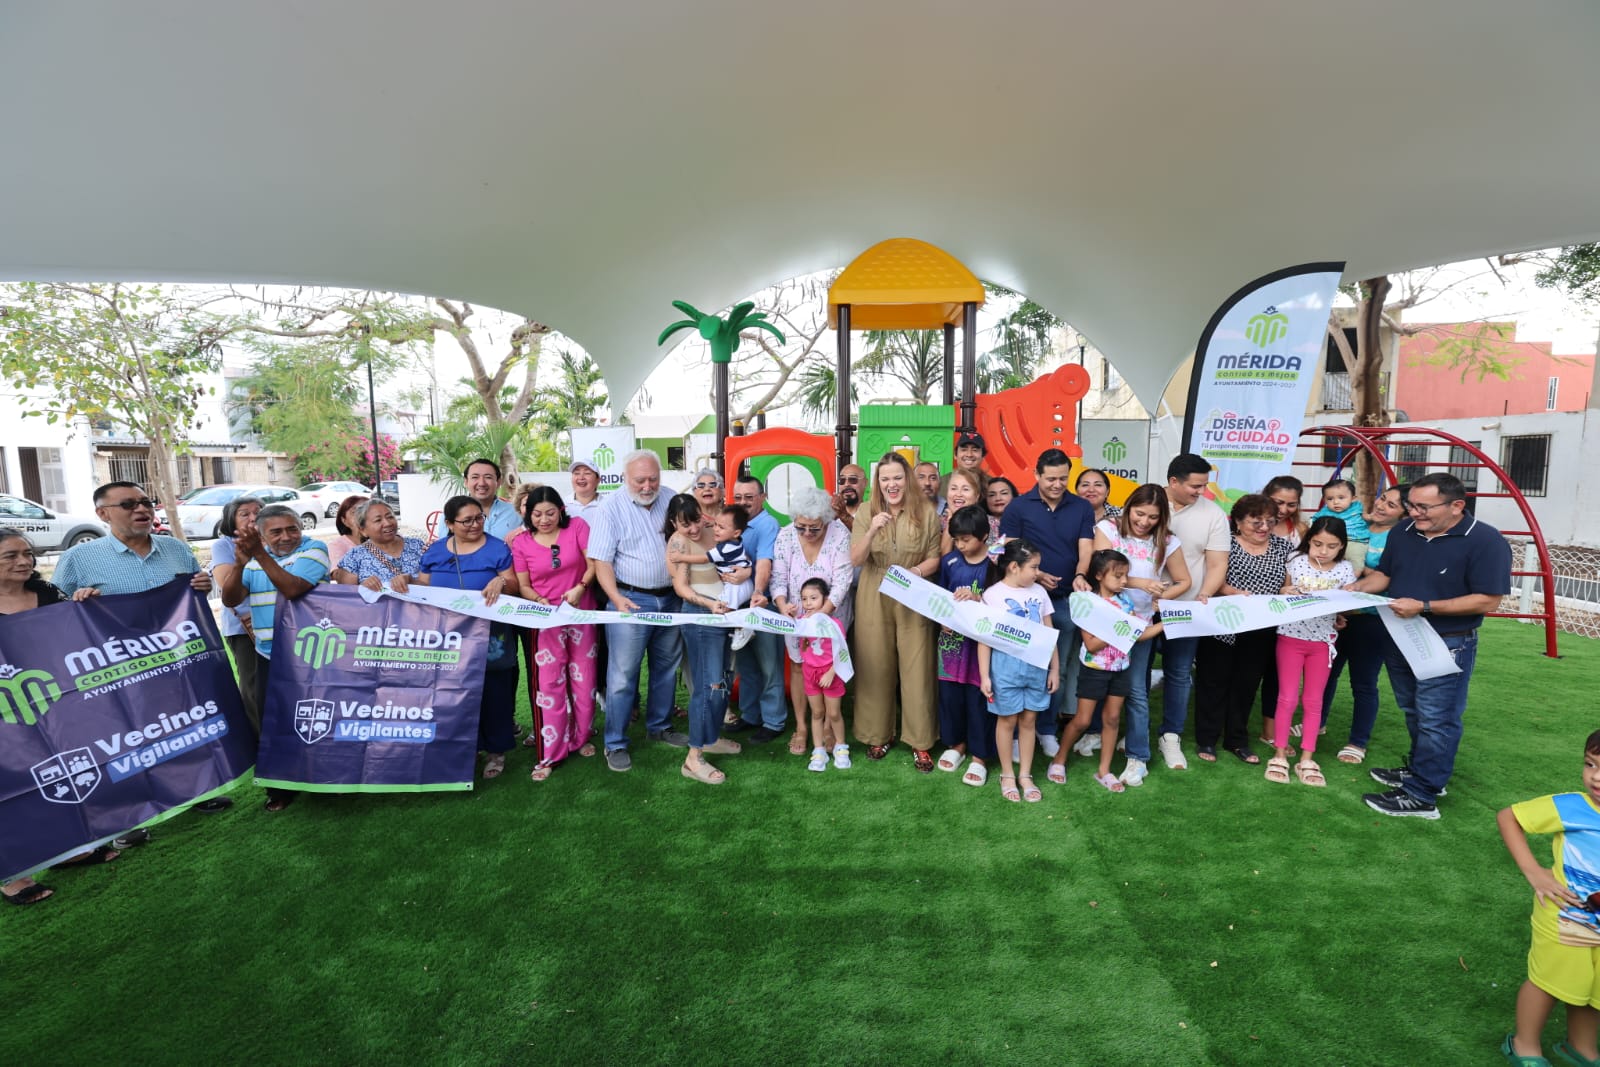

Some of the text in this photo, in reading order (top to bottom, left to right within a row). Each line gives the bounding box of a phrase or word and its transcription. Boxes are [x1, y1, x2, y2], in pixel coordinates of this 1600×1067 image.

[1217, 352, 1302, 371] MÉRIDA
[1268, 371, 1297, 380] MEJOR
[1213, 415, 1267, 431] DISEÑA
[1205, 430, 1290, 445] TU CIUDAD
[1161, 608, 1192, 617] ÉRIDA
[356, 624, 462, 650] MÉRIDA
[64, 620, 201, 676] MÉRIDA
[358, 649, 456, 661] CONTIGO ES MEJOR
[81, 660, 148, 686] CONTIGO
[152, 655, 166, 664] ES
[353, 660, 459, 671] AYUNTAMIENTO 2024-2027
[83, 666, 170, 700] AYUNTAMIENTO
[340, 700, 434, 720] Vecinos
[94, 700, 218, 756] Vecinos
[340, 721, 432, 741] Vigilantes
[111, 720, 226, 774] Vigilantes
